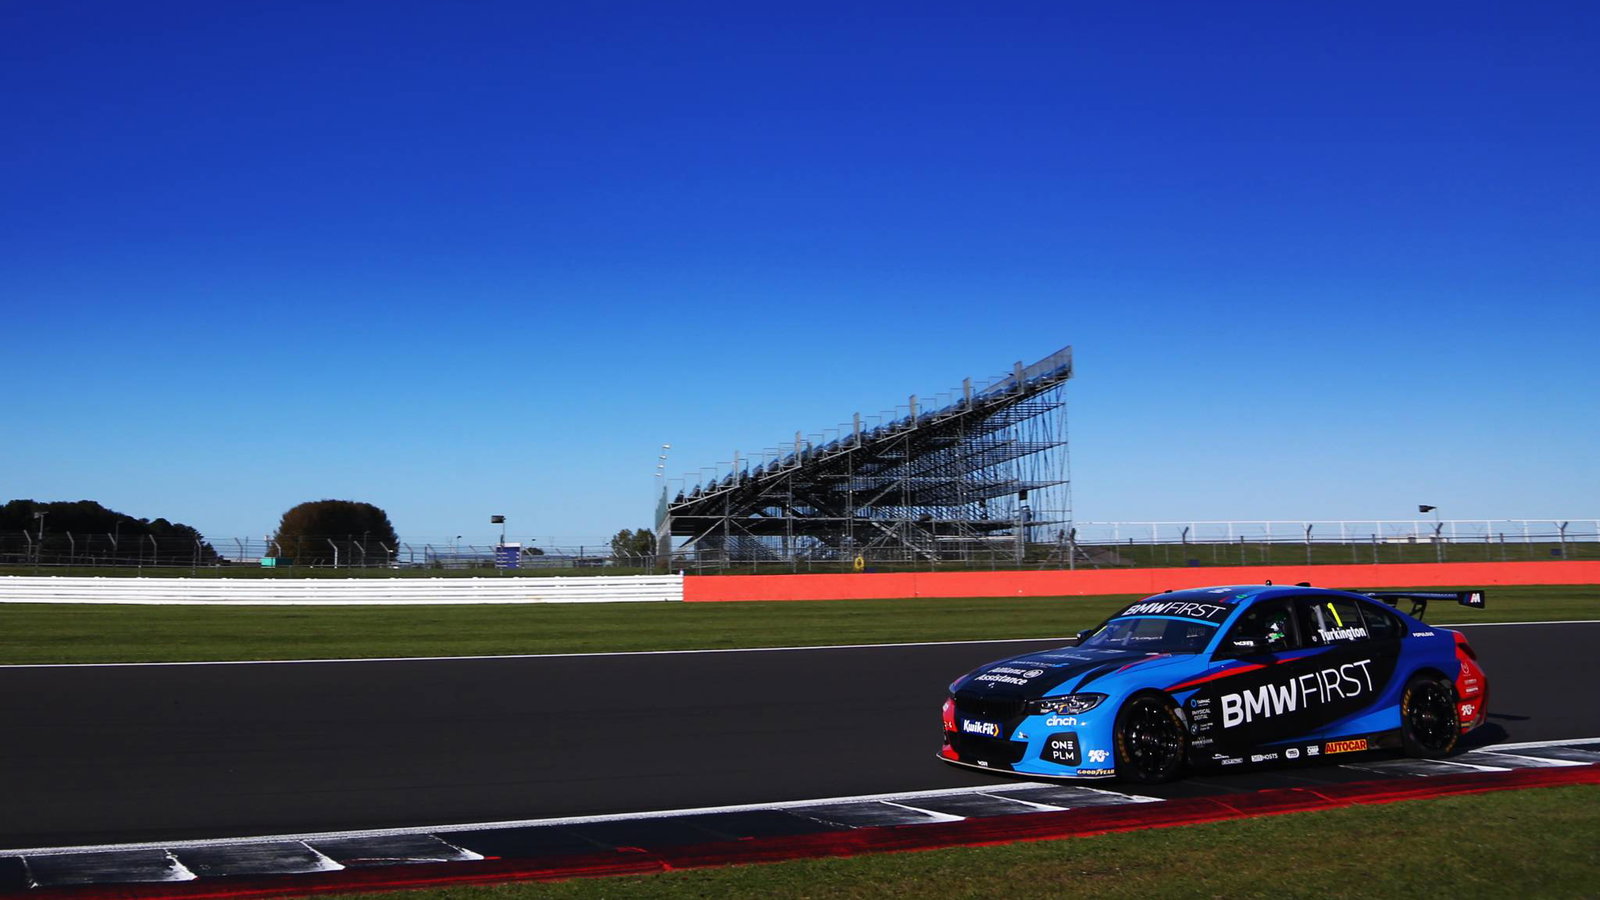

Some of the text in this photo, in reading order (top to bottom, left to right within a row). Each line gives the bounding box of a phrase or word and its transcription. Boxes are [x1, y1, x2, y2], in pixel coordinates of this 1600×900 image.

[1121, 602, 1227, 618] BMWFIRST
[1327, 602, 1344, 627] 1
[1318, 626, 1367, 642] Turkington
[988, 667, 1026, 675] Allianz
[974, 674, 1028, 686] Assistance
[1221, 659, 1373, 729] BMWFIRST
[1046, 715, 1077, 726] cinch
[1051, 740, 1074, 750] ONE
[1326, 740, 1367, 753] AUTOCAR
[1053, 750, 1074, 761] PLM
